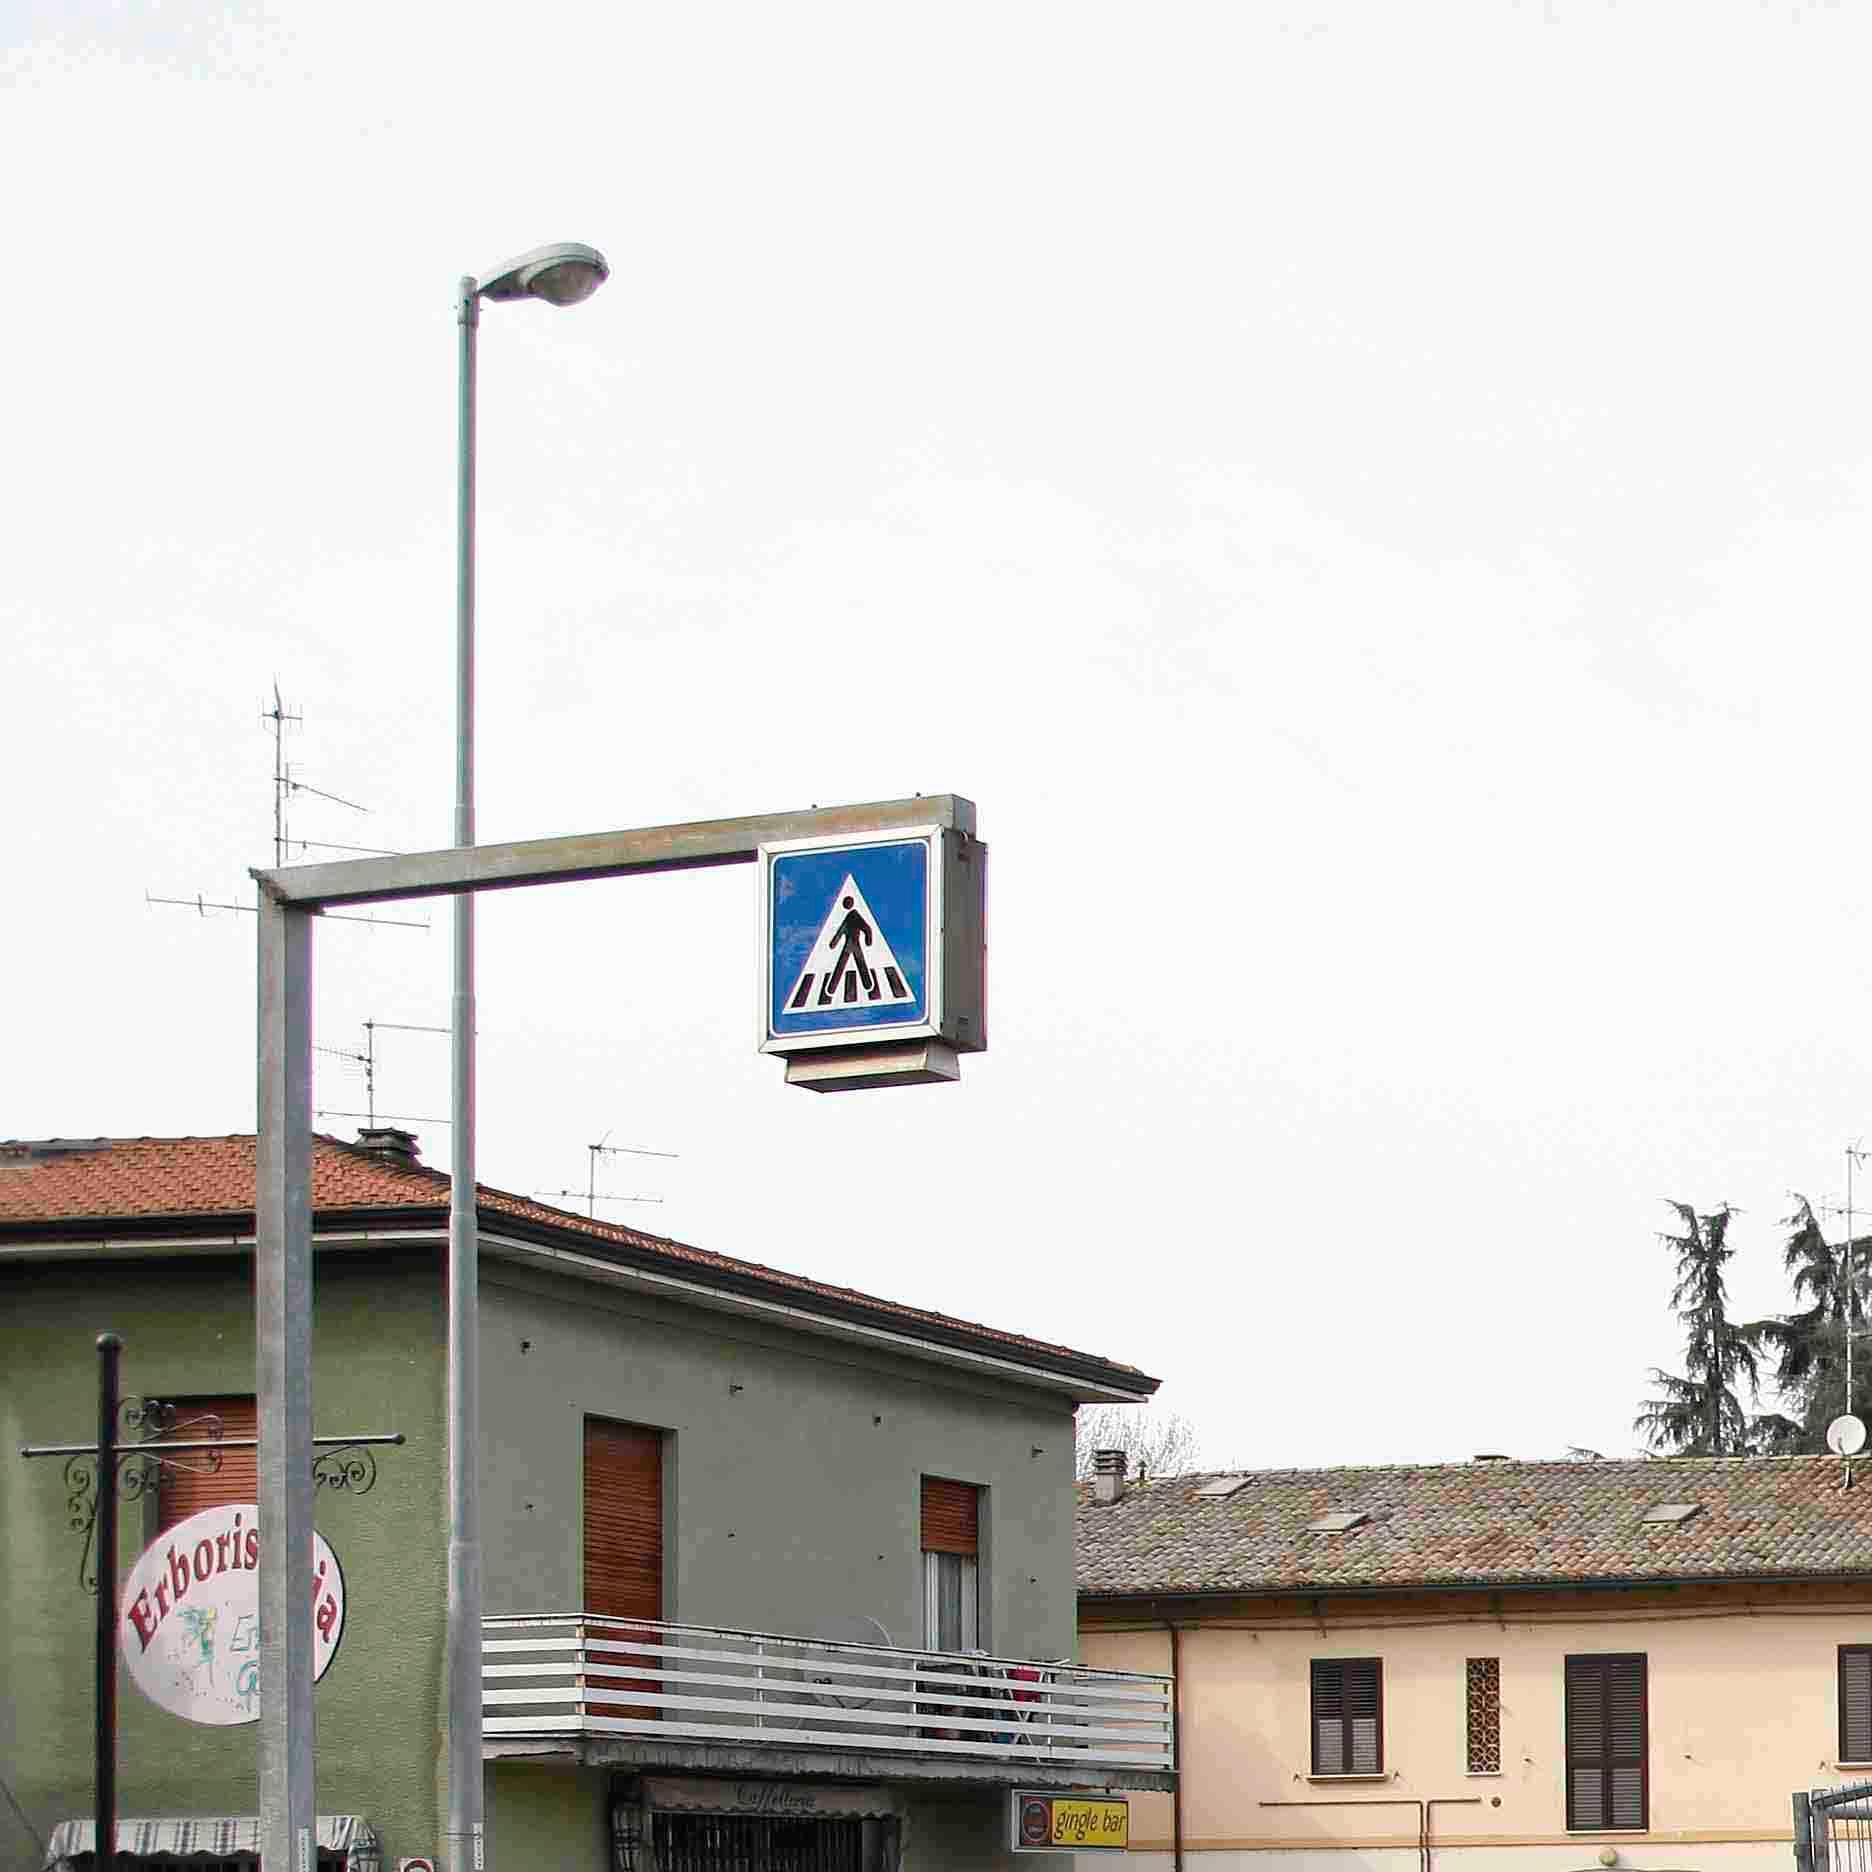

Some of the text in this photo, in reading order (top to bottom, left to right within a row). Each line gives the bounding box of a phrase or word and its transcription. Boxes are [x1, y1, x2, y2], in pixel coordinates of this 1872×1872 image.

[128, 1512, 337, 1654] Erborisia
[1054, 1805, 1126, 1841] gingle bar
